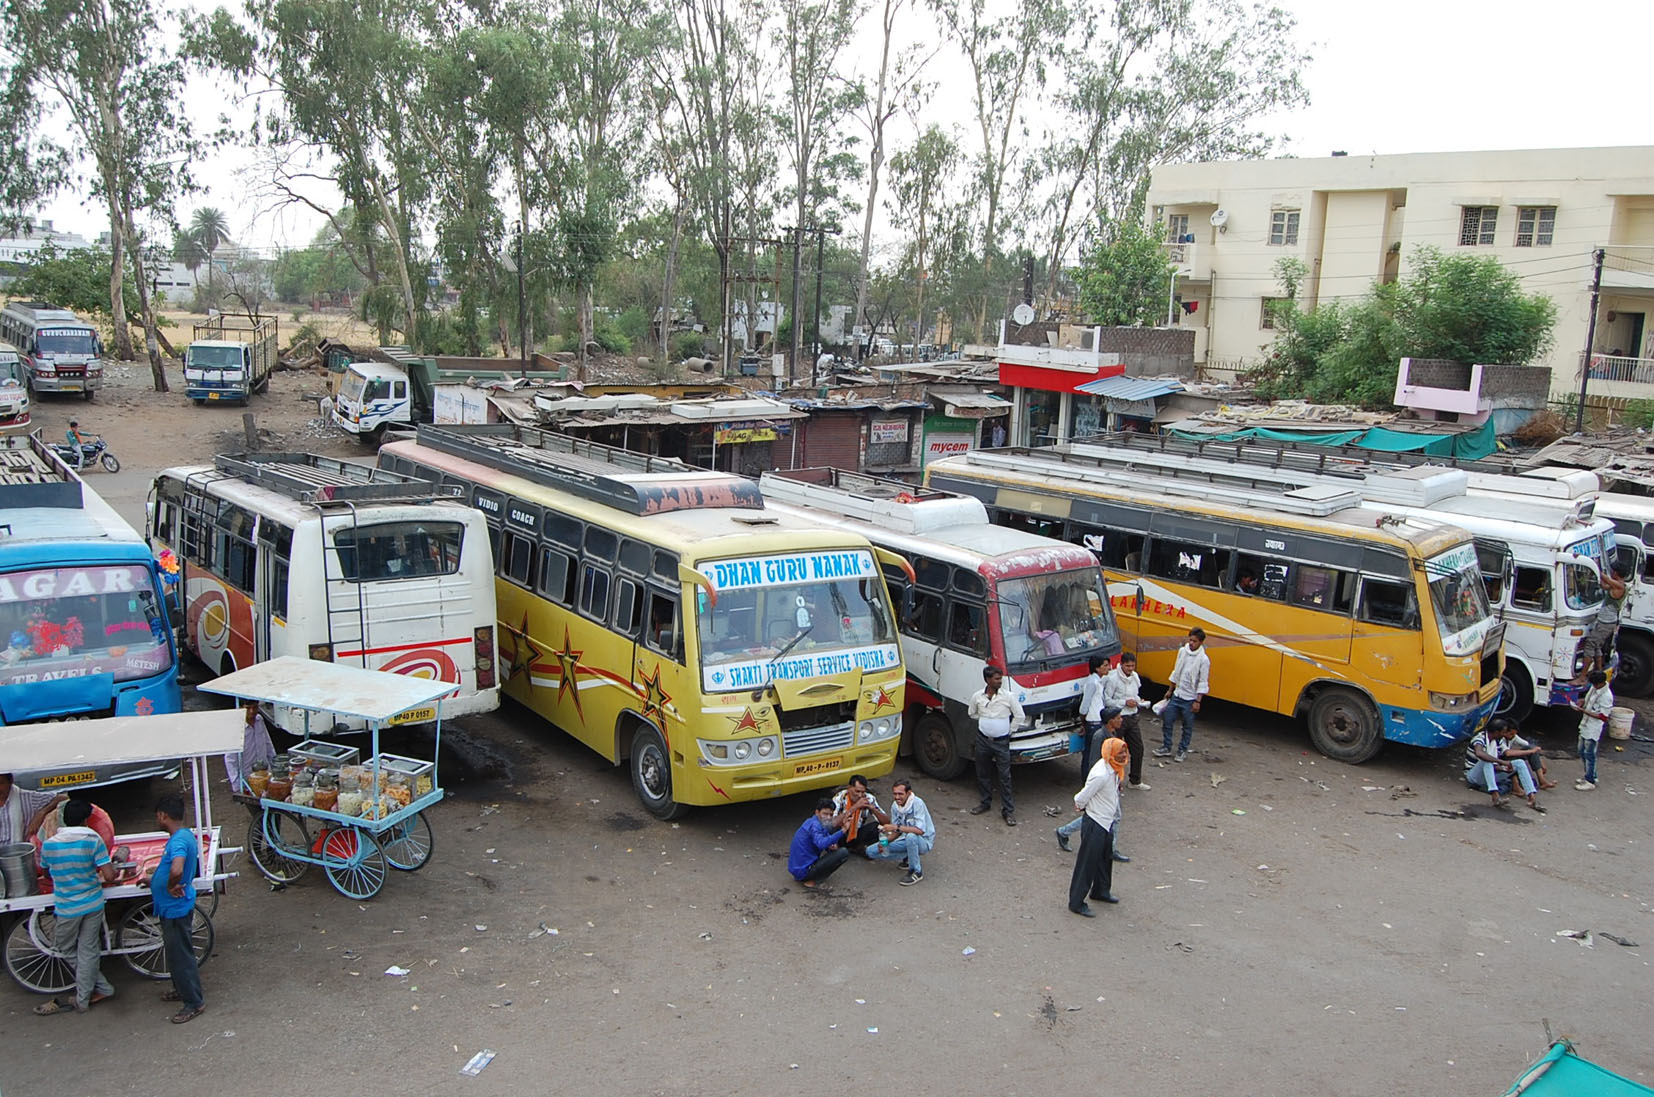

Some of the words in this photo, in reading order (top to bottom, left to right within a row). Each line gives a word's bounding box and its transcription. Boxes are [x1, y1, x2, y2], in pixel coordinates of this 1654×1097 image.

[930, 442, 969, 453] mycem
[478, 497, 499, 512] VIDIO
[511, 509, 535, 526] COACH
[714, 560, 762, 588] DHAN
[765, 556, 808, 583] GURU
[811, 553, 862, 579] NANAK
[729, 665, 763, 687] SHAKTI
[766, 658, 814, 681] TRANSPORT
[817, 652, 852, 676] SERVICE
[855, 650, 886, 672] VIDISHA
